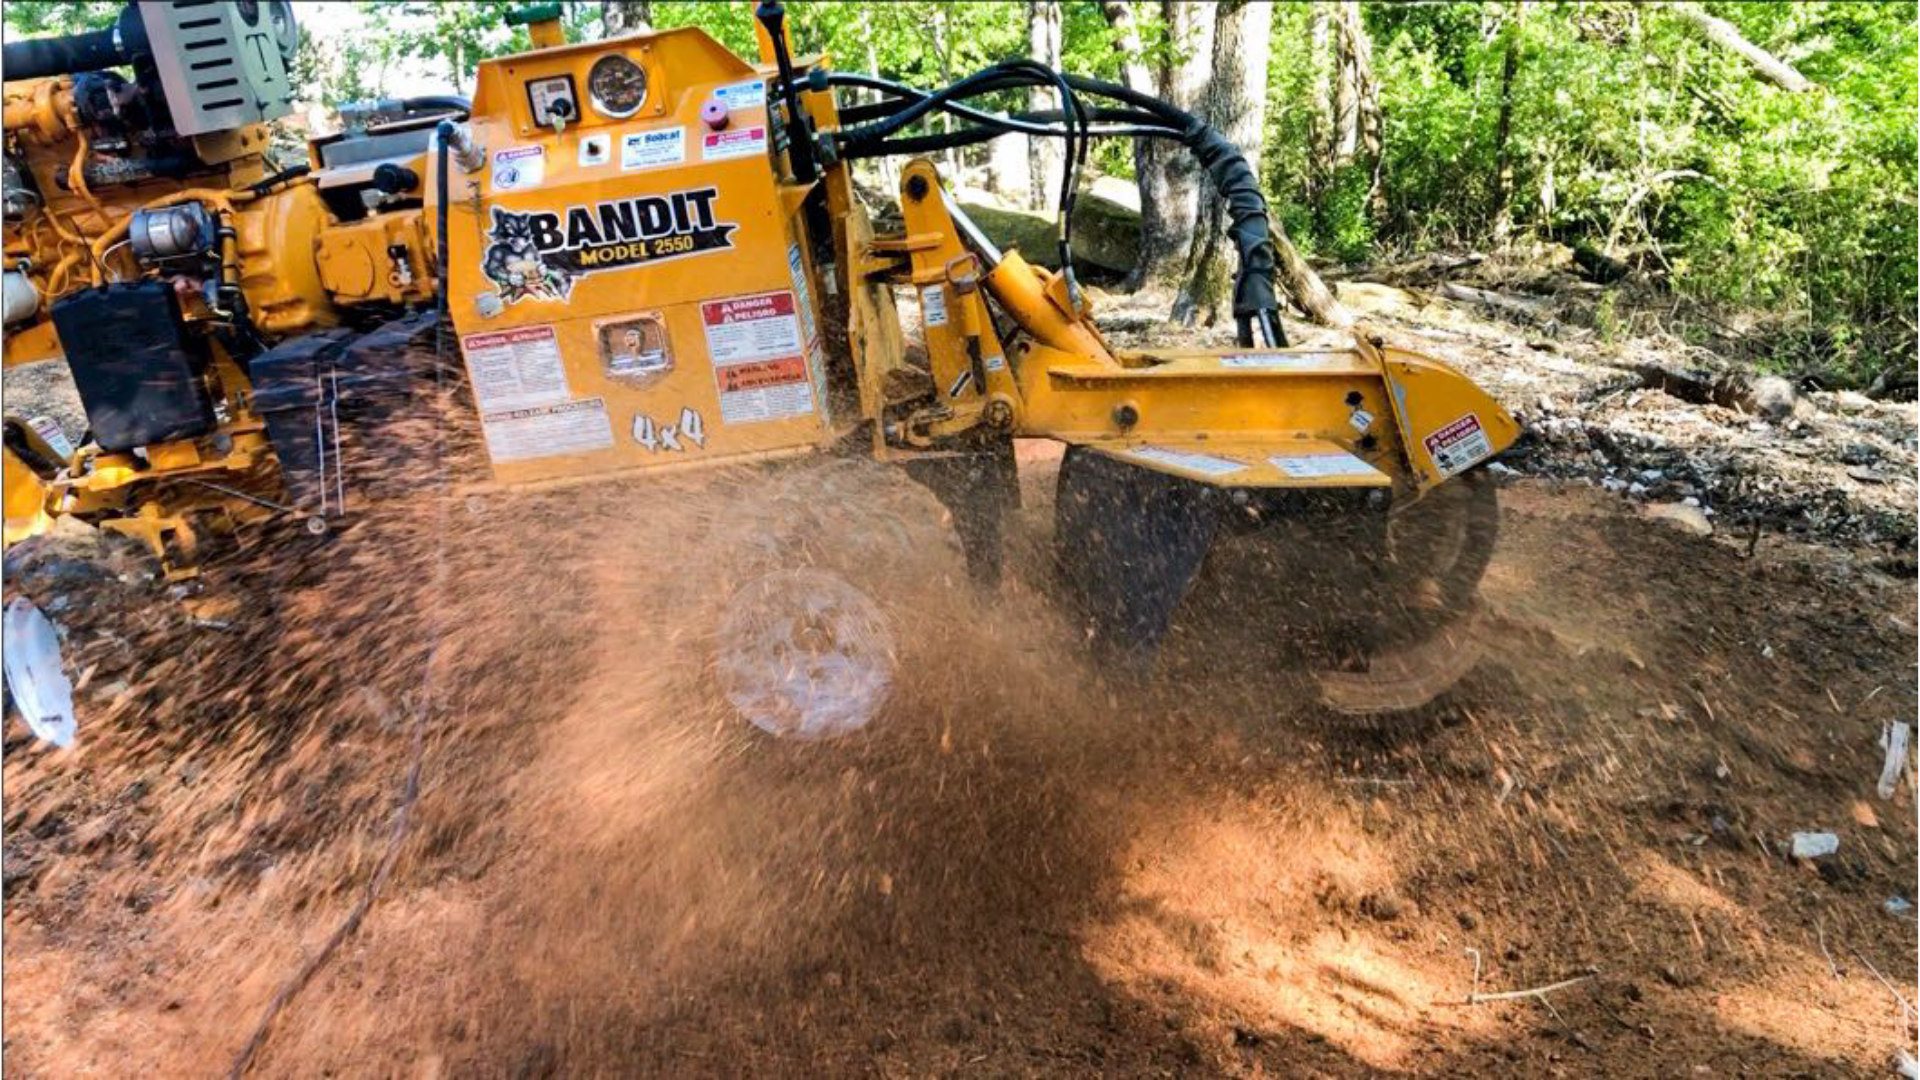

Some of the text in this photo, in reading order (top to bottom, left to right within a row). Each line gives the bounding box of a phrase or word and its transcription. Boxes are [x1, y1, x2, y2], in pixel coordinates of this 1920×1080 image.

[528, 188, 717, 251] BANDIT
[580, 234, 694, 266] MODEL 2550
[733, 297, 773, 310] DANGER
